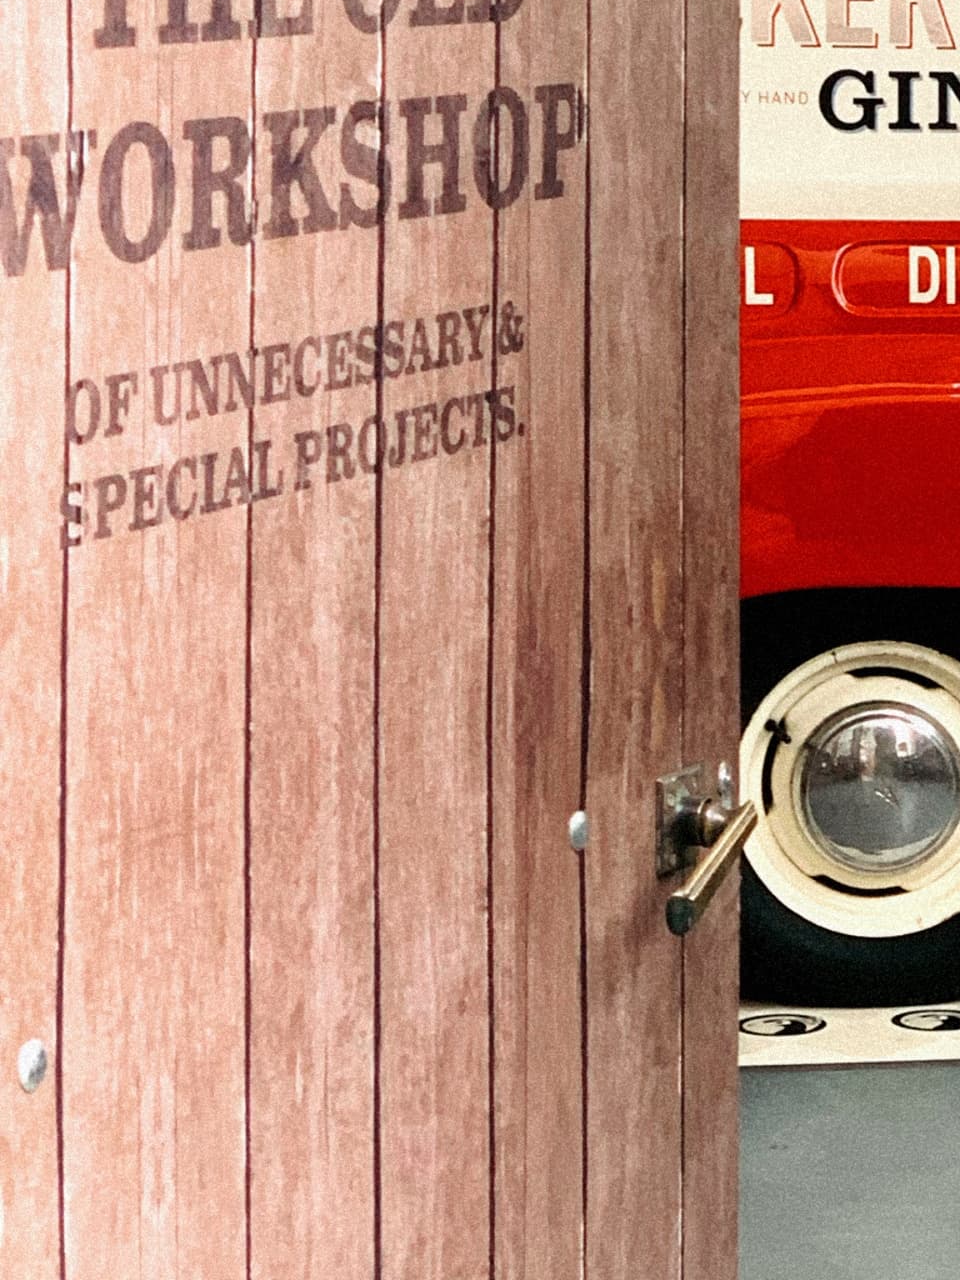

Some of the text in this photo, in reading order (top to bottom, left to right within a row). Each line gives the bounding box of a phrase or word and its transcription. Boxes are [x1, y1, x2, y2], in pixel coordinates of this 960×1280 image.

[758, 91, 809, 105] HAND
[0, 83, 590, 278] WORKSHOP
[745, 246, 774, 305] L
[67, 301, 525, 445] OF UNNECESSARY &
[60, 385, 526, 550] SPECIAL PROJECTS.
